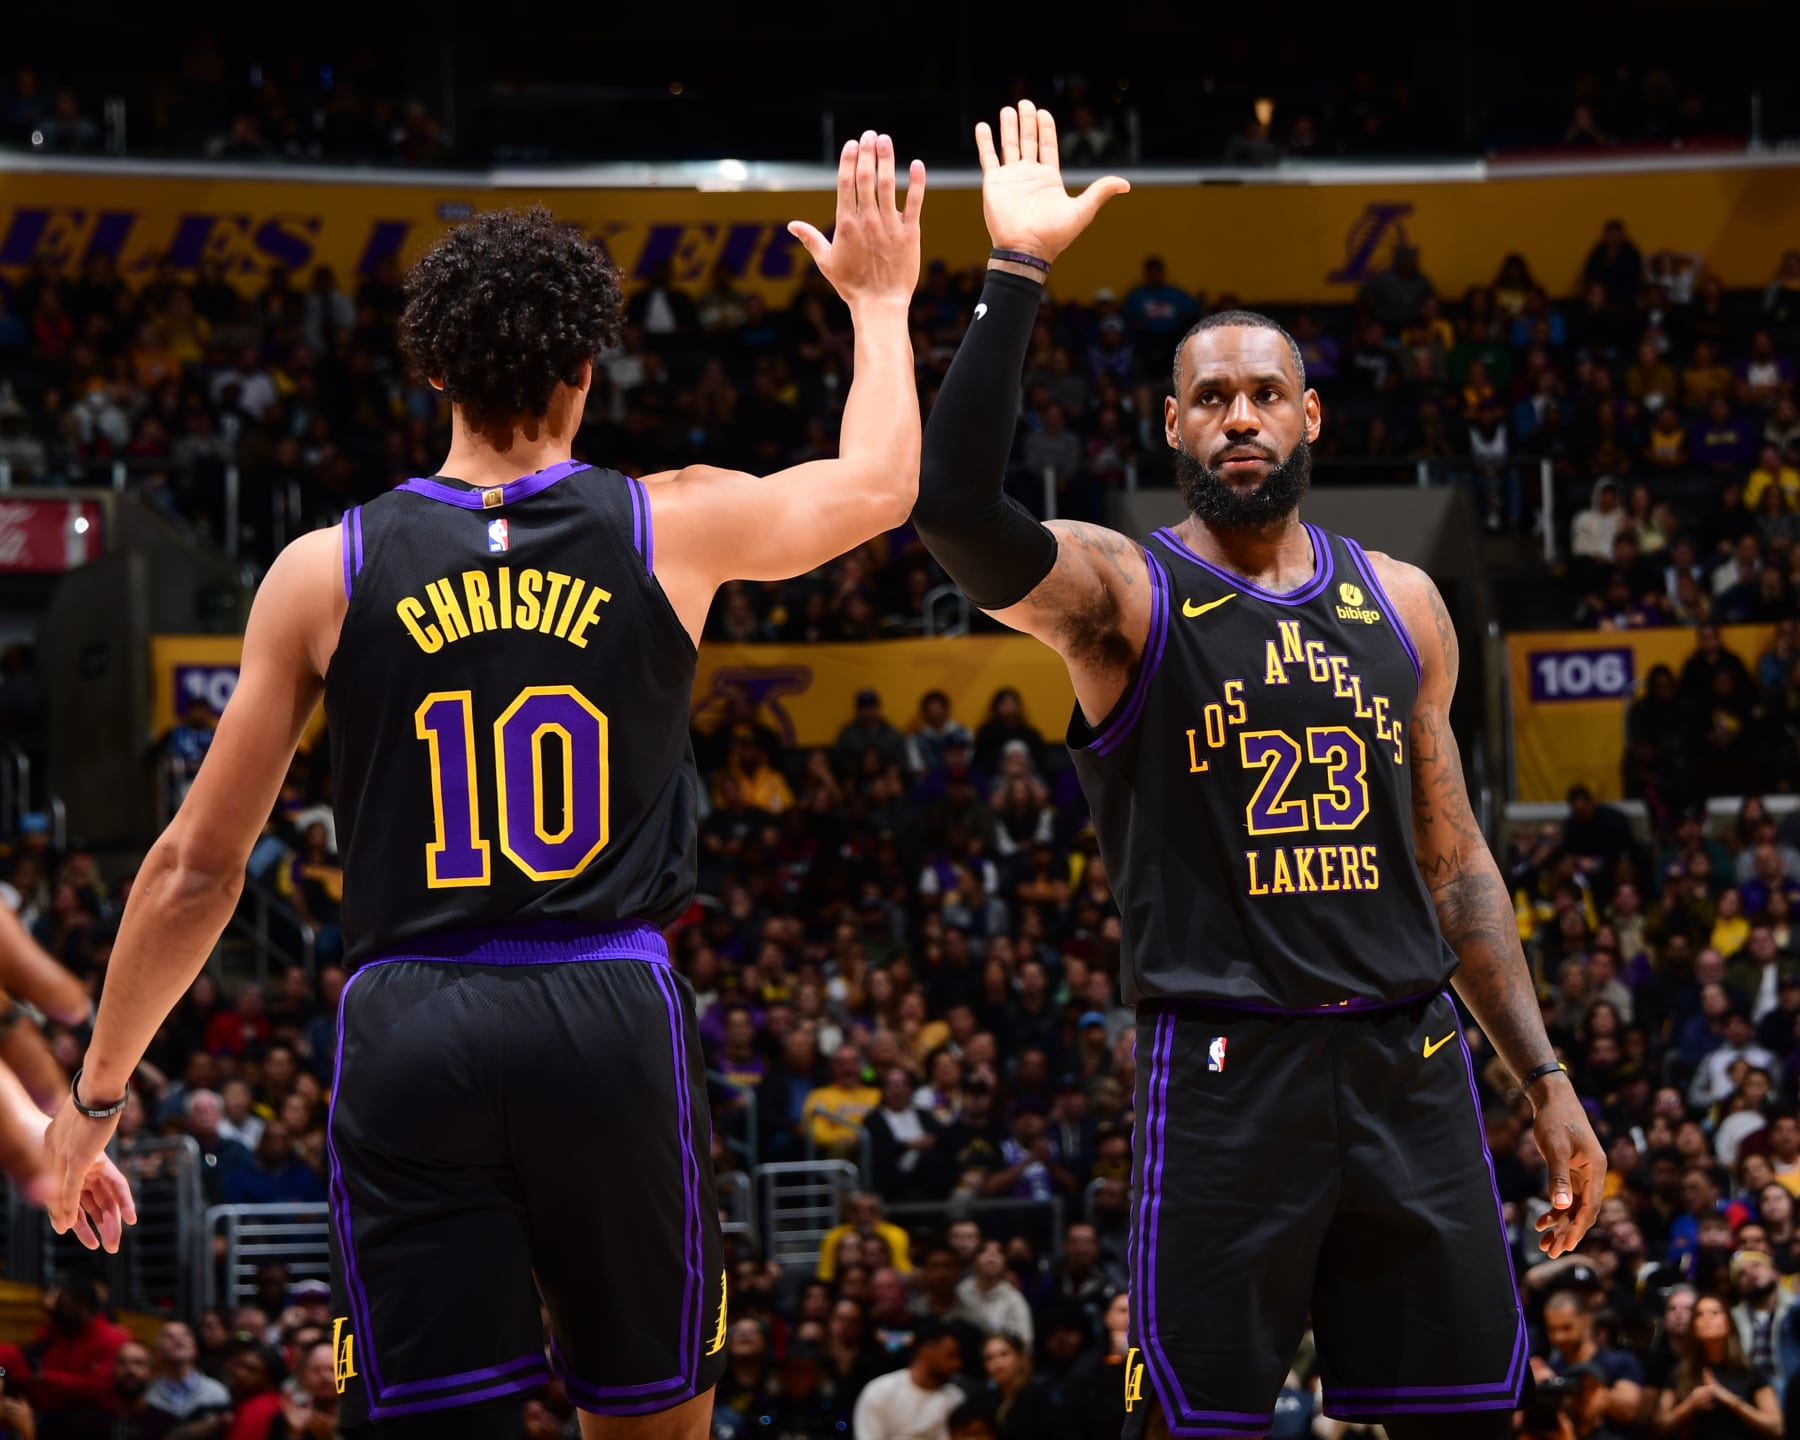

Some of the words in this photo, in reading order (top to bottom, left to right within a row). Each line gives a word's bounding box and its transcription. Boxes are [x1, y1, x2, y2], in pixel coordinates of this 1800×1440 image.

[396, 566, 613, 654] CHRISTIE
[1336, 605, 1380, 625] bibigo
[1185, 679, 1248, 774] LOS
[1263, 619, 1404, 766] ANGELES
[1537, 653, 1626, 696] 106
[414, 684, 609, 889] 10
[1239, 725, 1370, 836] 23
[1245, 844, 1380, 896] LAKERS
